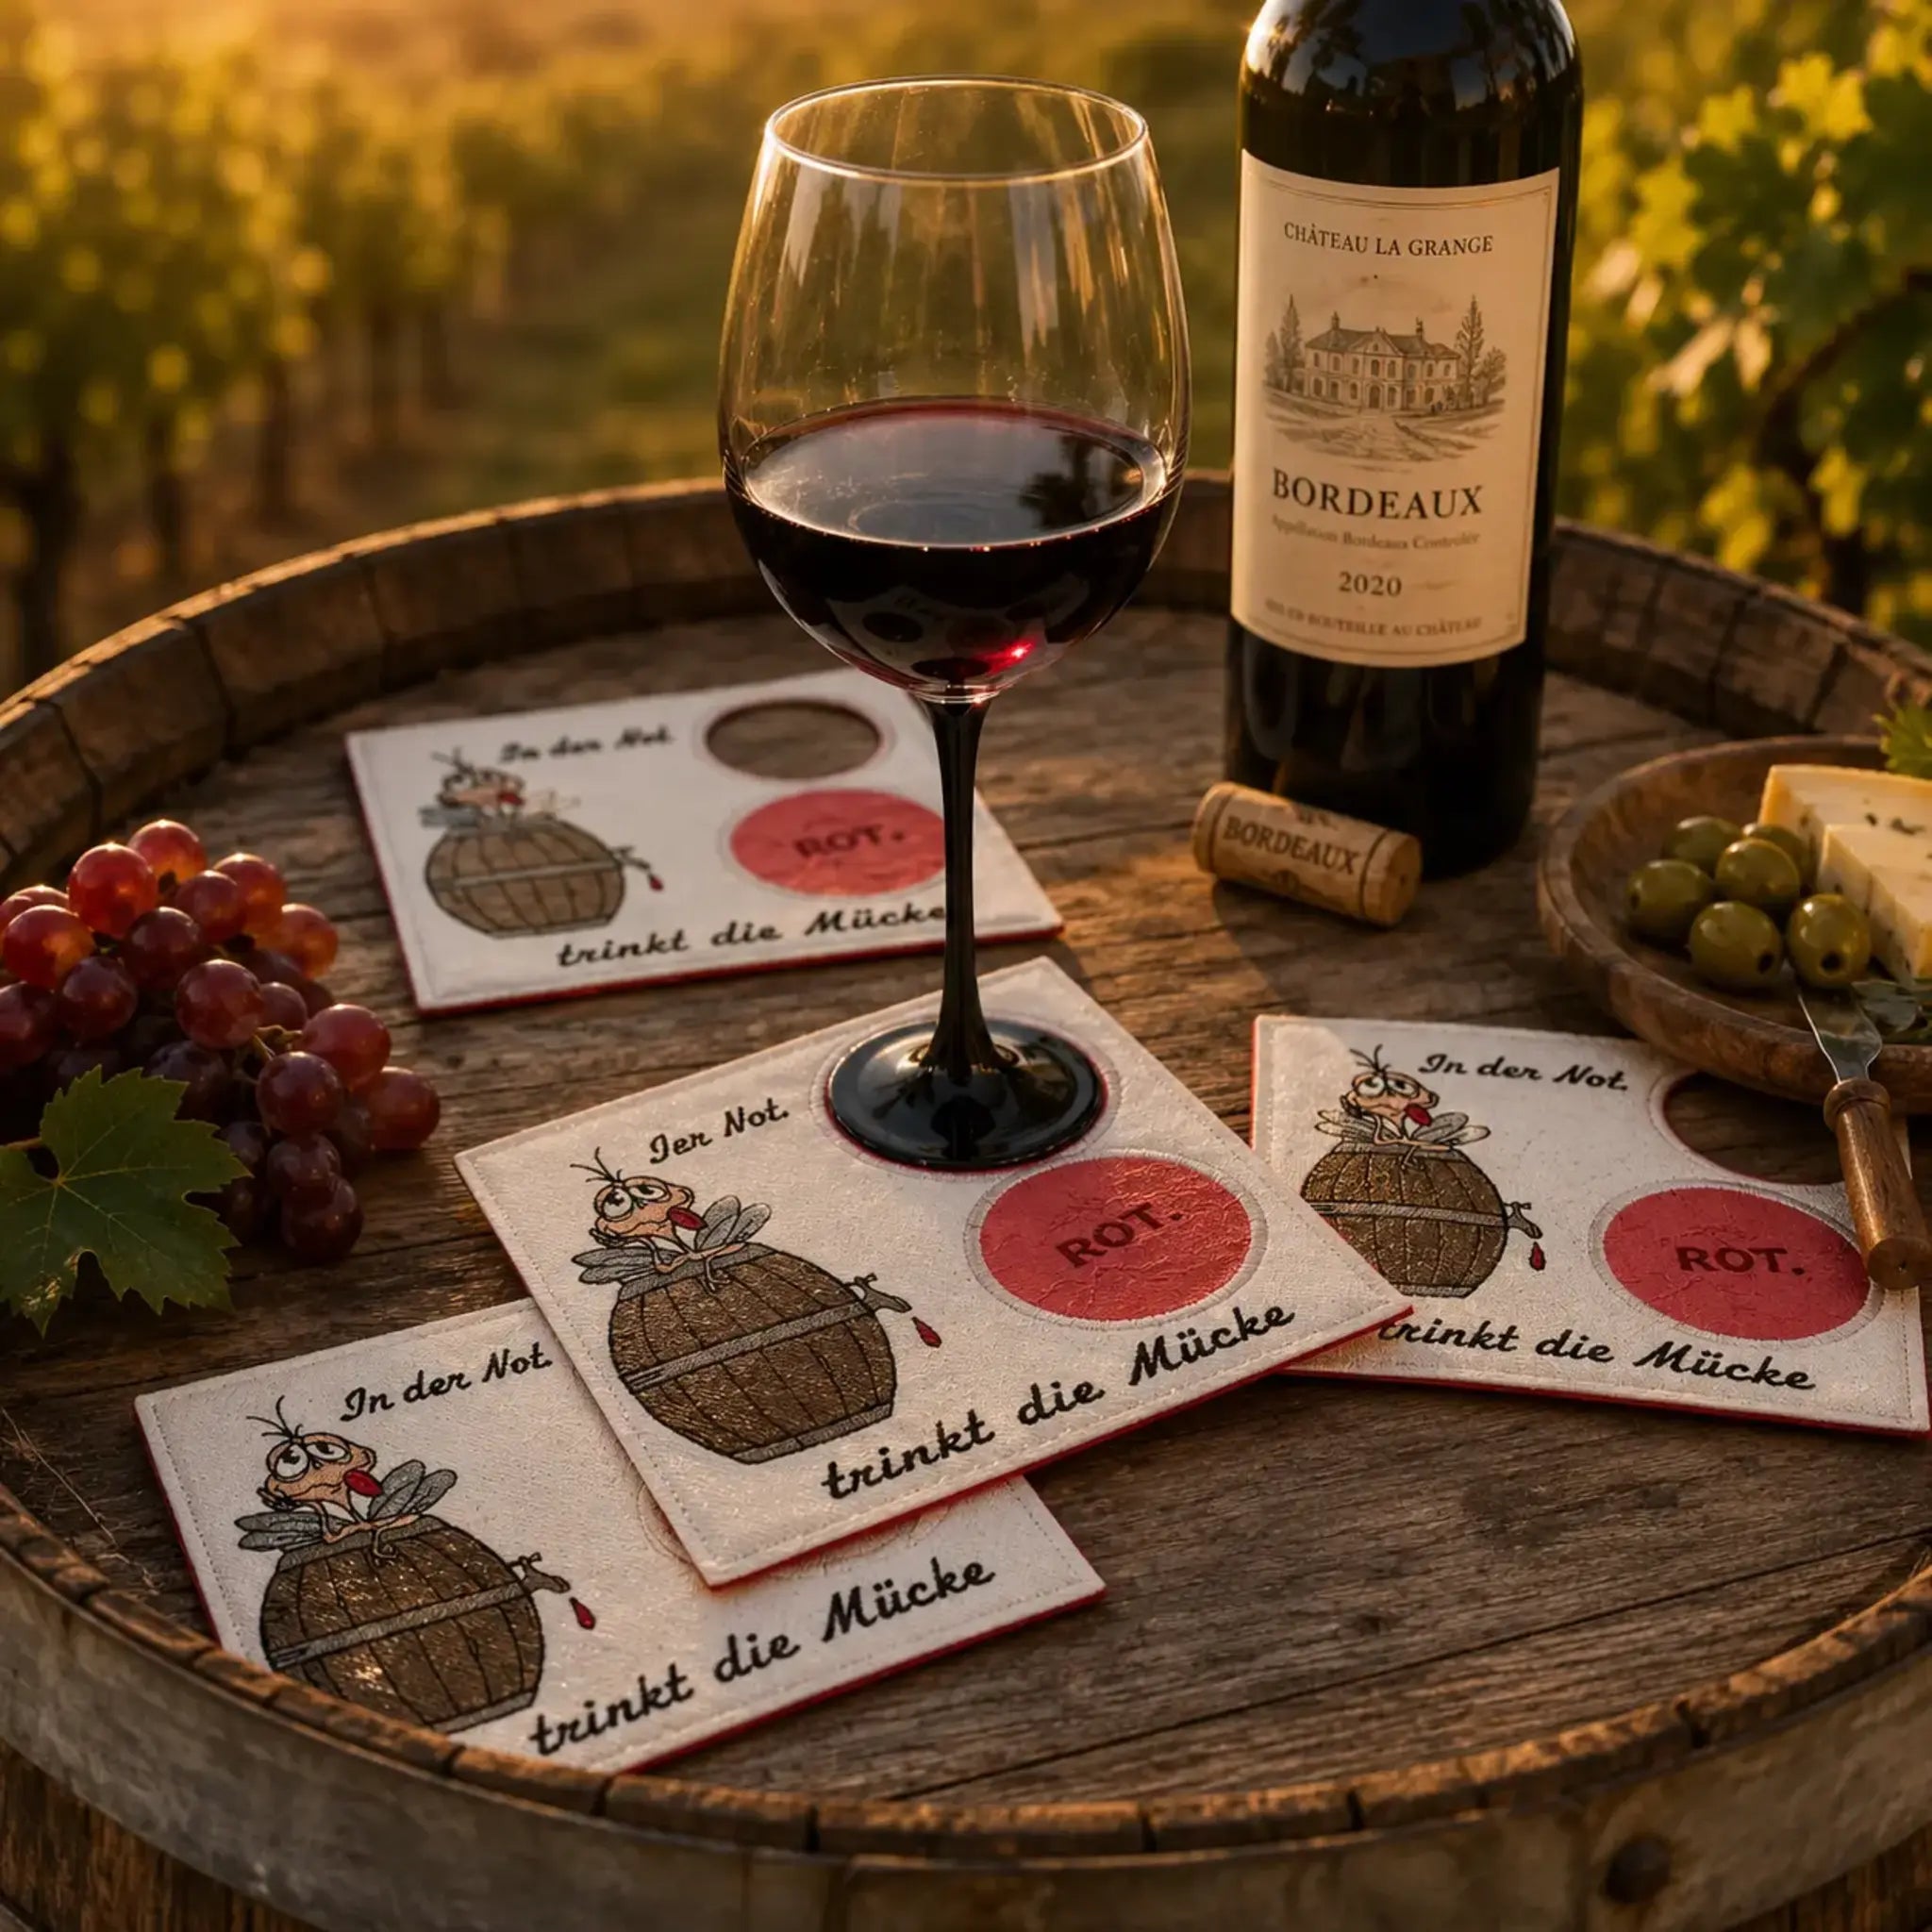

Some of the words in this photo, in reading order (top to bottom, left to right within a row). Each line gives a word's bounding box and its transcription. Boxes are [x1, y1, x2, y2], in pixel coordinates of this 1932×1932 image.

[1375, 238, 1401, 256] LA
[1407, 235, 1494, 257] GRANGE
[1273, 468, 1483, 520] BORDEAUX
[1343, 531, 1408, 549] Bordeaux
[1339, 572, 1402, 597] 2020
[1392, 623, 1413, 636] AU
[794, 823, 906, 858] ROT.
[1224, 816, 1360, 875] BORDEAUX
[558, 928, 689, 968] trinkt
[710, 921, 782, 946] die
[804, 902, 945, 937] Mücke
[1418, 1053, 1467, 1074] In
[1477, 1056, 1542, 1081] der
[1056, 1202, 1183, 1268] ROT.
[1675, 1247, 1806, 1275] ROT.
[1535, 1329, 1616, 1363] die
[1633, 1341, 1816, 1391] Mücke
[340, 1387, 395, 1423] In
[403, 1370, 472, 1404] der
[822, 1408, 995, 1500] trinkt
[1017, 1383, 1106, 1426] die
[1128, 1306, 1296, 1386] Mücke
[529, 1663, 694, 1756] trinkt
[714, 1634, 801, 1685] die
[821, 1557, 995, 1643] Mücke
